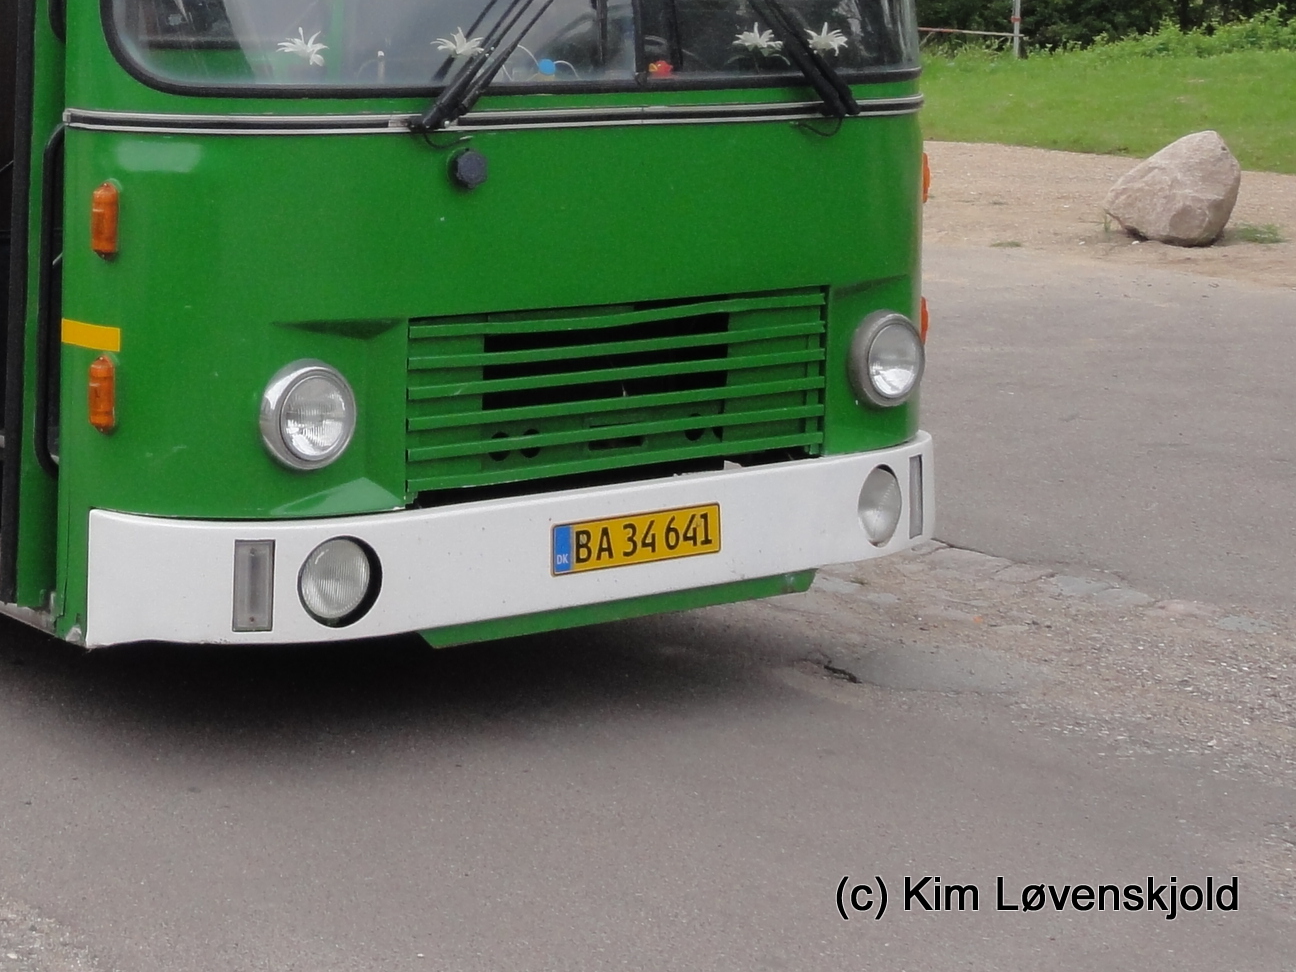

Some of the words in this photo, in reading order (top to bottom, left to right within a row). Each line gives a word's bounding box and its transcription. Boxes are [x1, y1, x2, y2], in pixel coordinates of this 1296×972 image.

[556, 553, 569, 565] DK
[574, 526, 614, 564] BA
[622, 519, 656, 558] 34
[664, 511, 713, 551] 641
